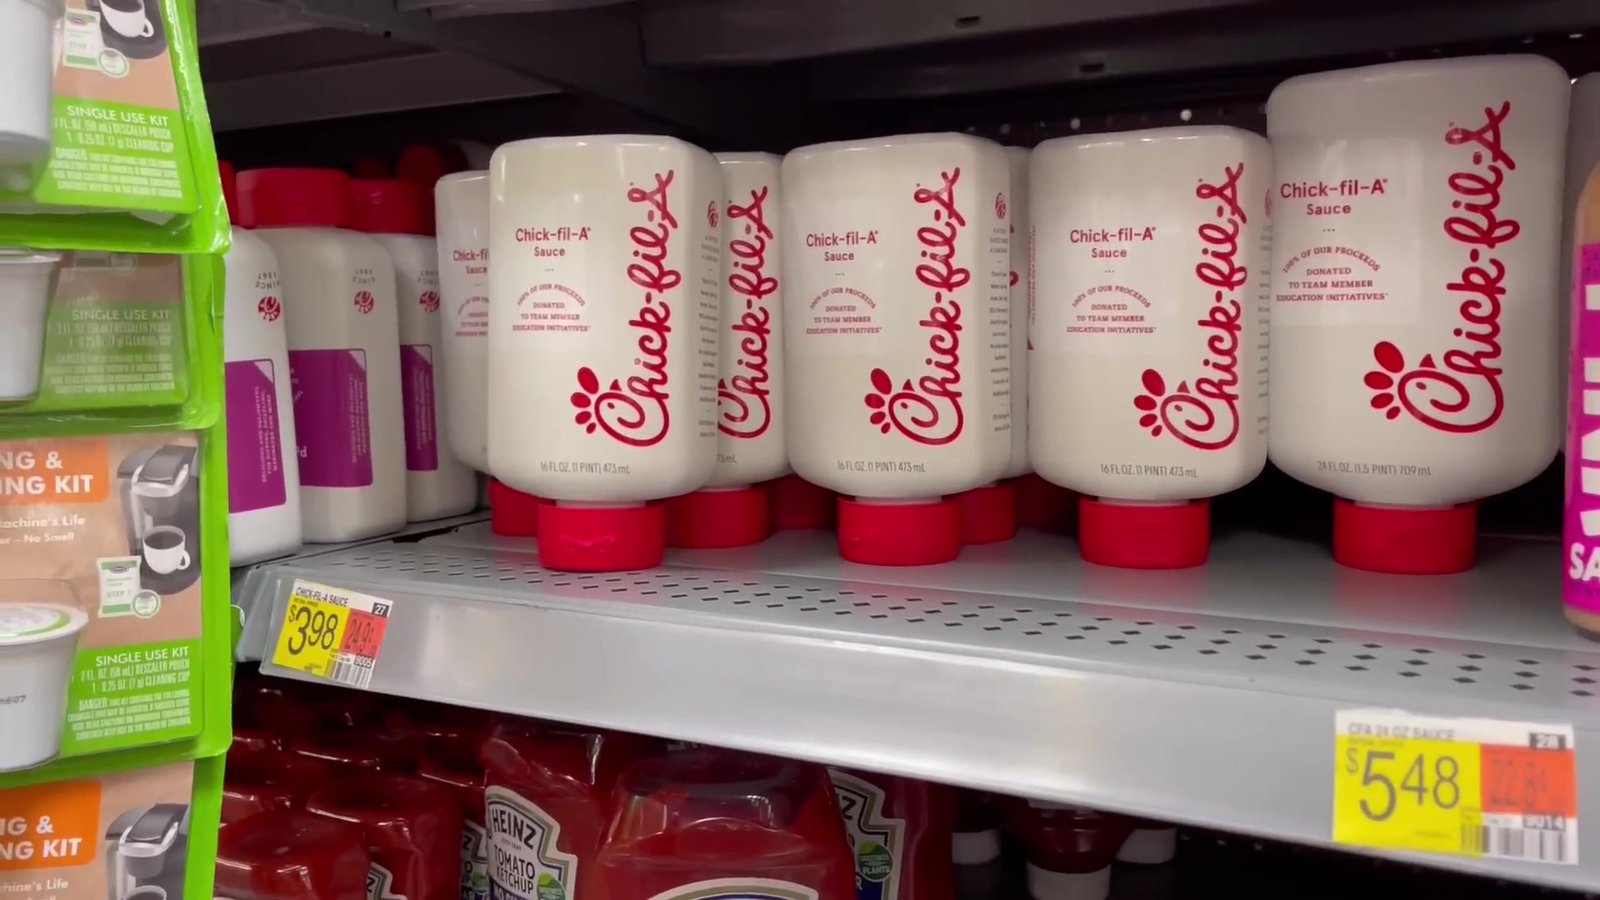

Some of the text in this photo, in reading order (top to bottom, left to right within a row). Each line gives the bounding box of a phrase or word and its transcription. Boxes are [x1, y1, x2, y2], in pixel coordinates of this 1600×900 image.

[67, 105, 168, 127] SINGLE USE KIT
[1306, 203, 1352, 216] Sauce
[534, 246, 566, 257] Sauce
[824, 251, 855, 262] Sauce
[1091, 247, 1128, 259] Sauce
[1300, 249, 1312, 259] OF
[1313, 246, 1332, 255] OUR
[1335, 246, 1381, 272] PROCEEDS
[1306, 267, 1352, 276] DONATED
[1288, 280, 1373, 289] TO TEAM MEMBER
[845, 287, 876, 309] PROCEEDS
[1087, 287, 1096, 296] OF
[1097, 285, 1113, 293] OUR
[1115, 285, 1151, 309] PROCEEDS
[1276, 294, 1324, 302] EDUCATION
[72, 309, 119, 320] SINGLE
[124, 309, 148, 320] USE
[45, 450, 63, 469] &
[603, 463, 617, 474] 473
[617, 464, 630, 474] mL
[898, 462, 912, 472] 473
[913, 464, 926, 473] mL
[1100, 463, 1110, 474] 16
[1144, 465, 1167, 477] PINT)
[1168, 466, 1184, 477] 473
[1184, 467, 1198, 478] mL
[1372, 464, 1397, 476] PINT)
[1400, 465, 1416, 476] 709
[1417, 465, 1432, 476] mL
[55, 474, 94, 494] KIT
[0, 514, 86, 528] achine's Life
[329, 594, 349, 607] SAUCE
[374, 604, 387, 615] 27
[95, 646, 189, 667] SINGLE USE KIT
[1413, 727, 1455, 742] SAUCE
[36, 816, 54, 834] &
[492, 808, 537, 850] HEINZ
[42, 838, 83, 858] KIT
[494, 844, 535, 879] TOMATO
[46, 878, 69, 889] Life
[497, 866, 534, 894] KETCHUP
